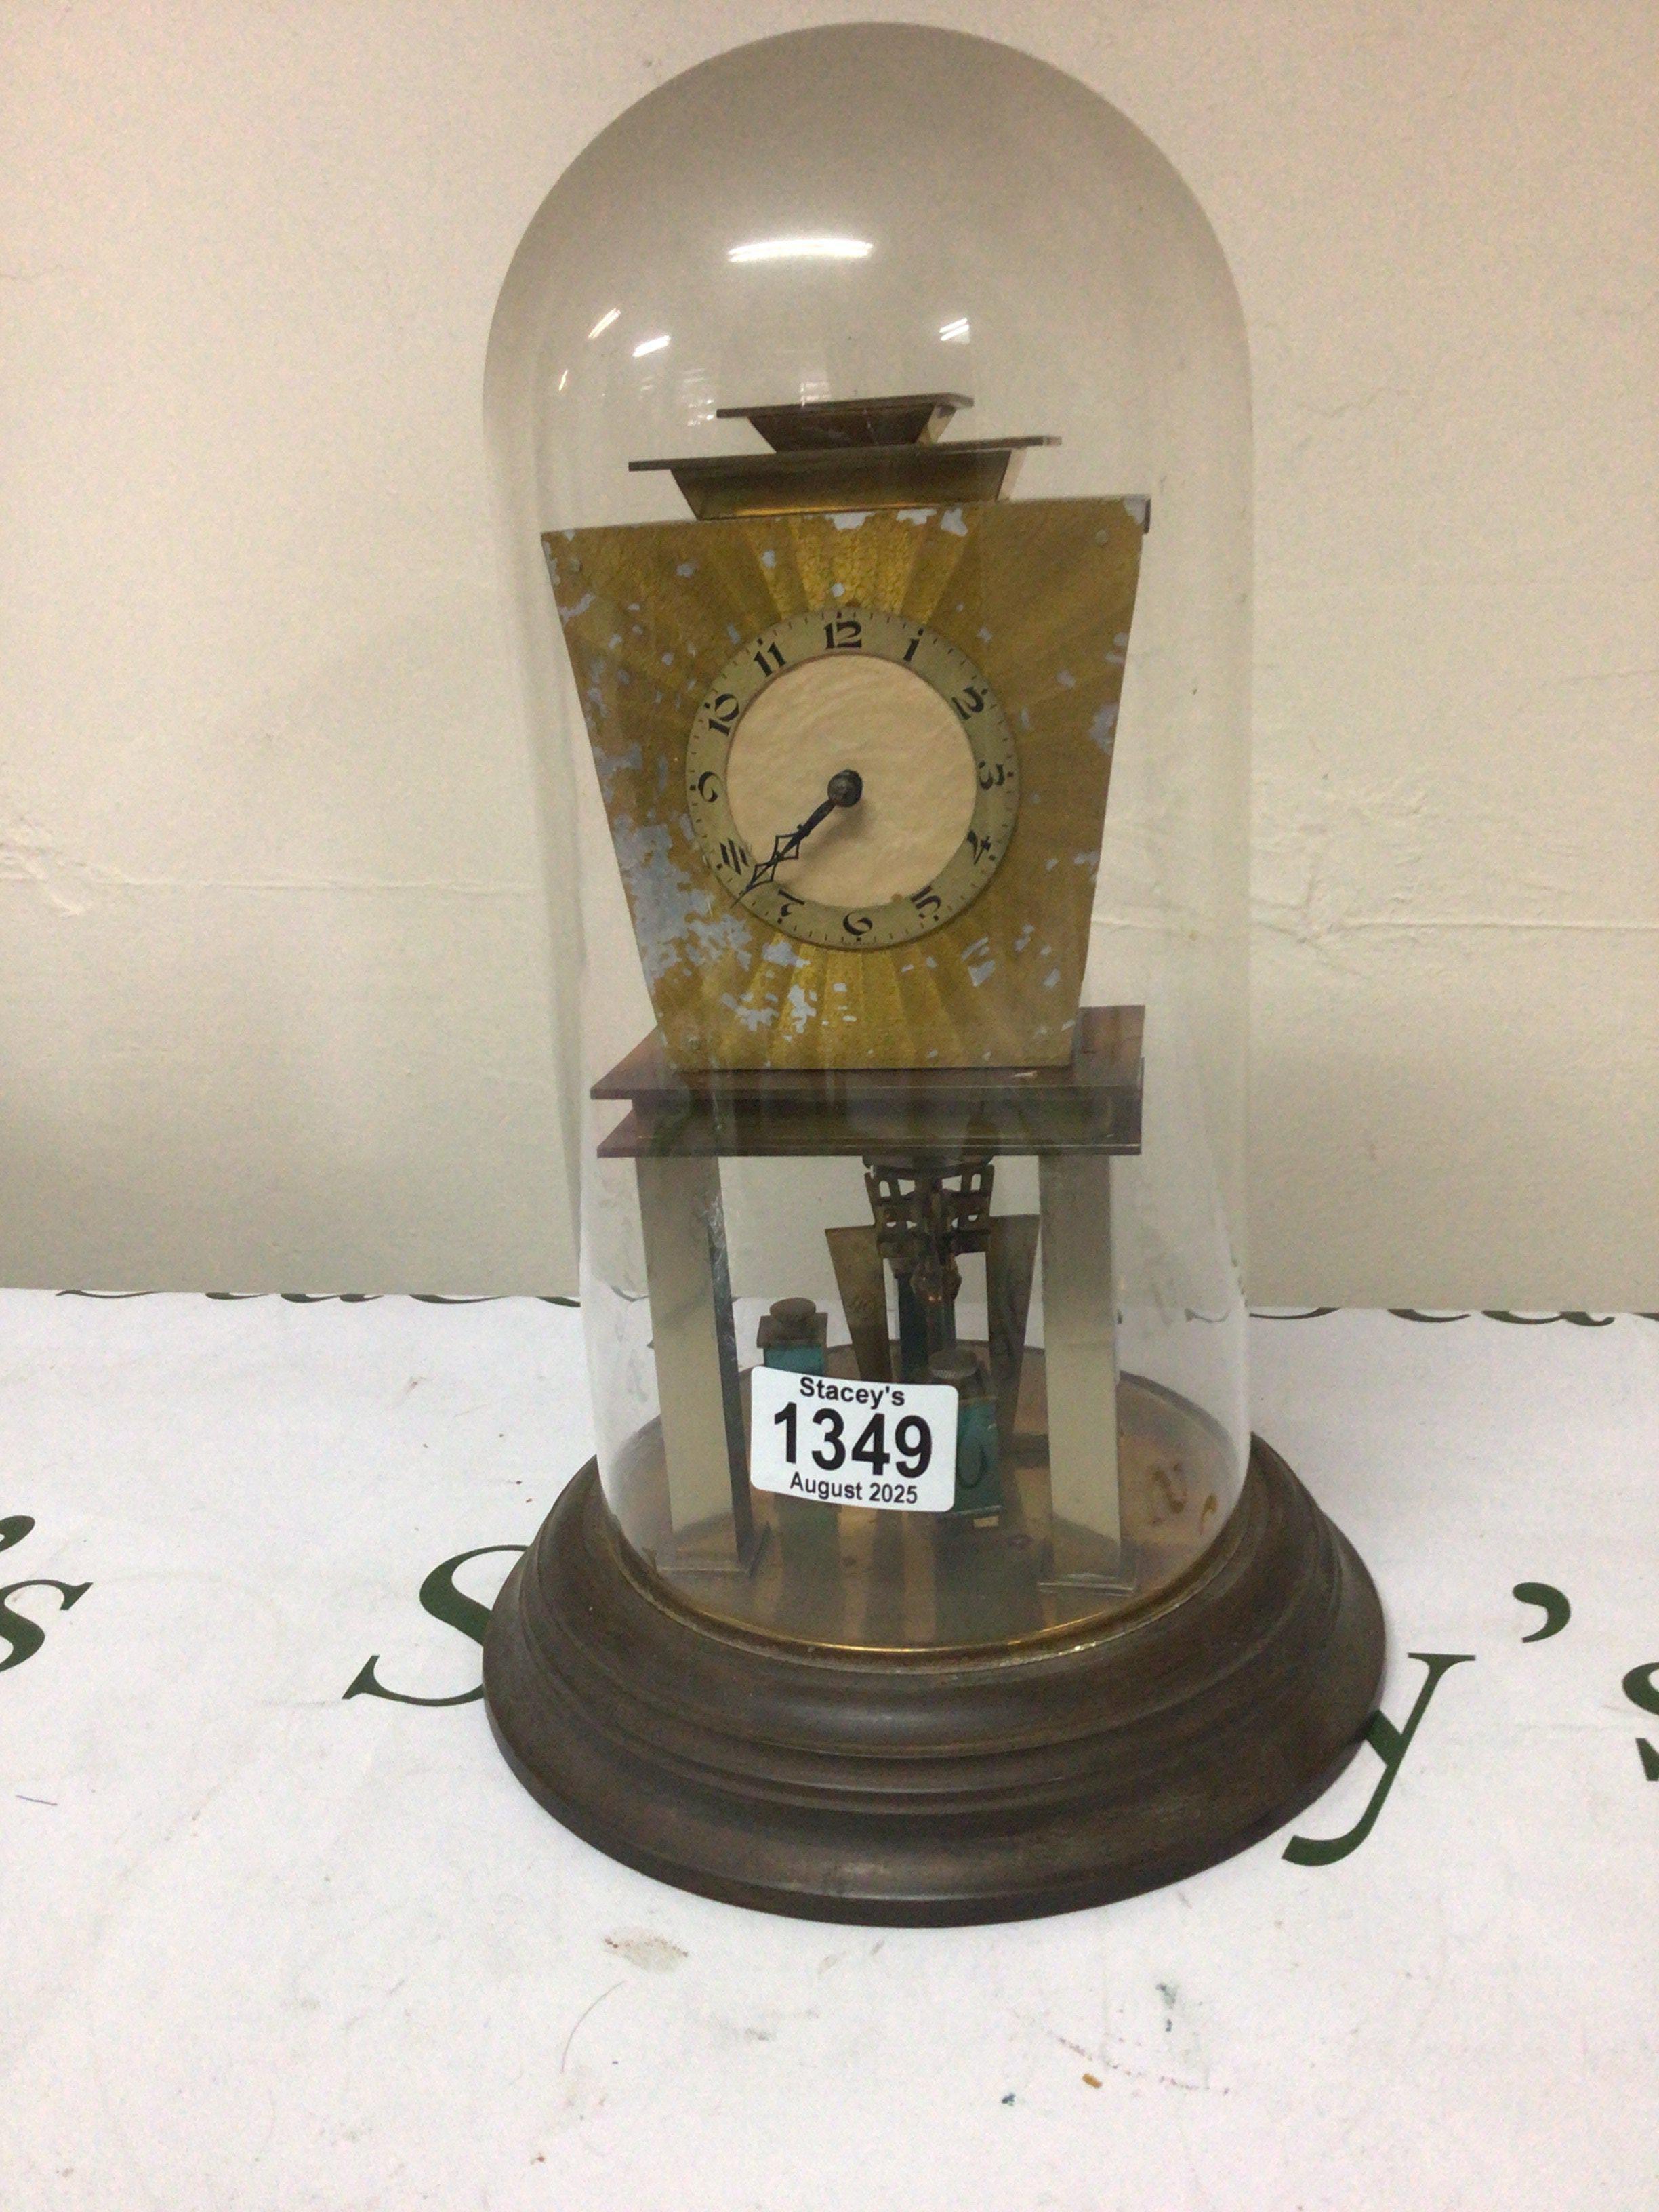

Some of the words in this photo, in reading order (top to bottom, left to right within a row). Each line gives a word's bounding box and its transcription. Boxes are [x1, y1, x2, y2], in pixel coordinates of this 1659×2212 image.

[824, 620, 863, 650] 12
[903, 630, 923, 662] 1
[754, 641, 787, 678] 11
[708, 693, 740, 737] 10
[951, 686, 985, 720] 2
[697, 771, 719, 803] 9
[979, 761, 1006, 790] 3
[966, 830, 992, 865] 4
[910, 885, 942, 918] 5
[842, 912, 874, 936] 6
[800, 1376, 905, 1410] Stacey's
[774, 1401, 933, 1479] 1349
[790, 1471, 863, 1500] August
[869, 1482, 918, 1504] 2025
